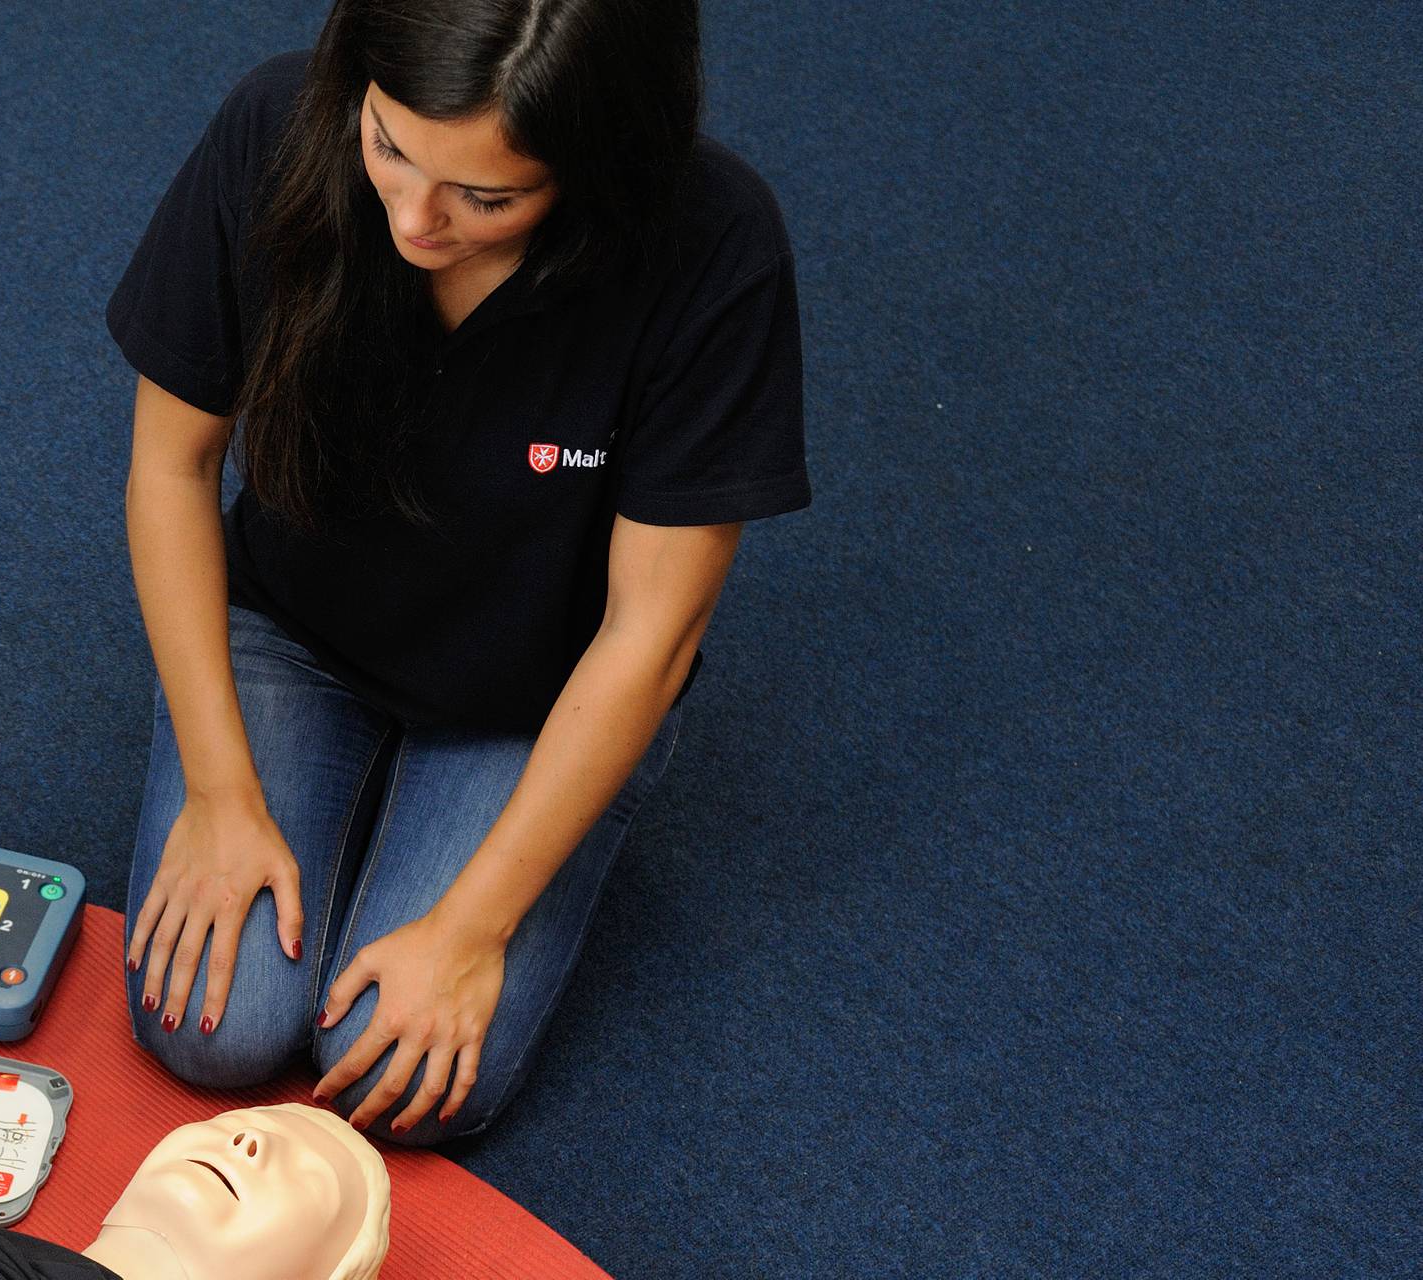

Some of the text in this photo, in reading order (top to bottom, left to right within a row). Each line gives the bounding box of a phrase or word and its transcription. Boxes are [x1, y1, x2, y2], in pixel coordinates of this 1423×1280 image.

[562, 448, 607, 468] Malt
[21, 878, 31, 890] 1
[0, 919, 13, 932] 2
